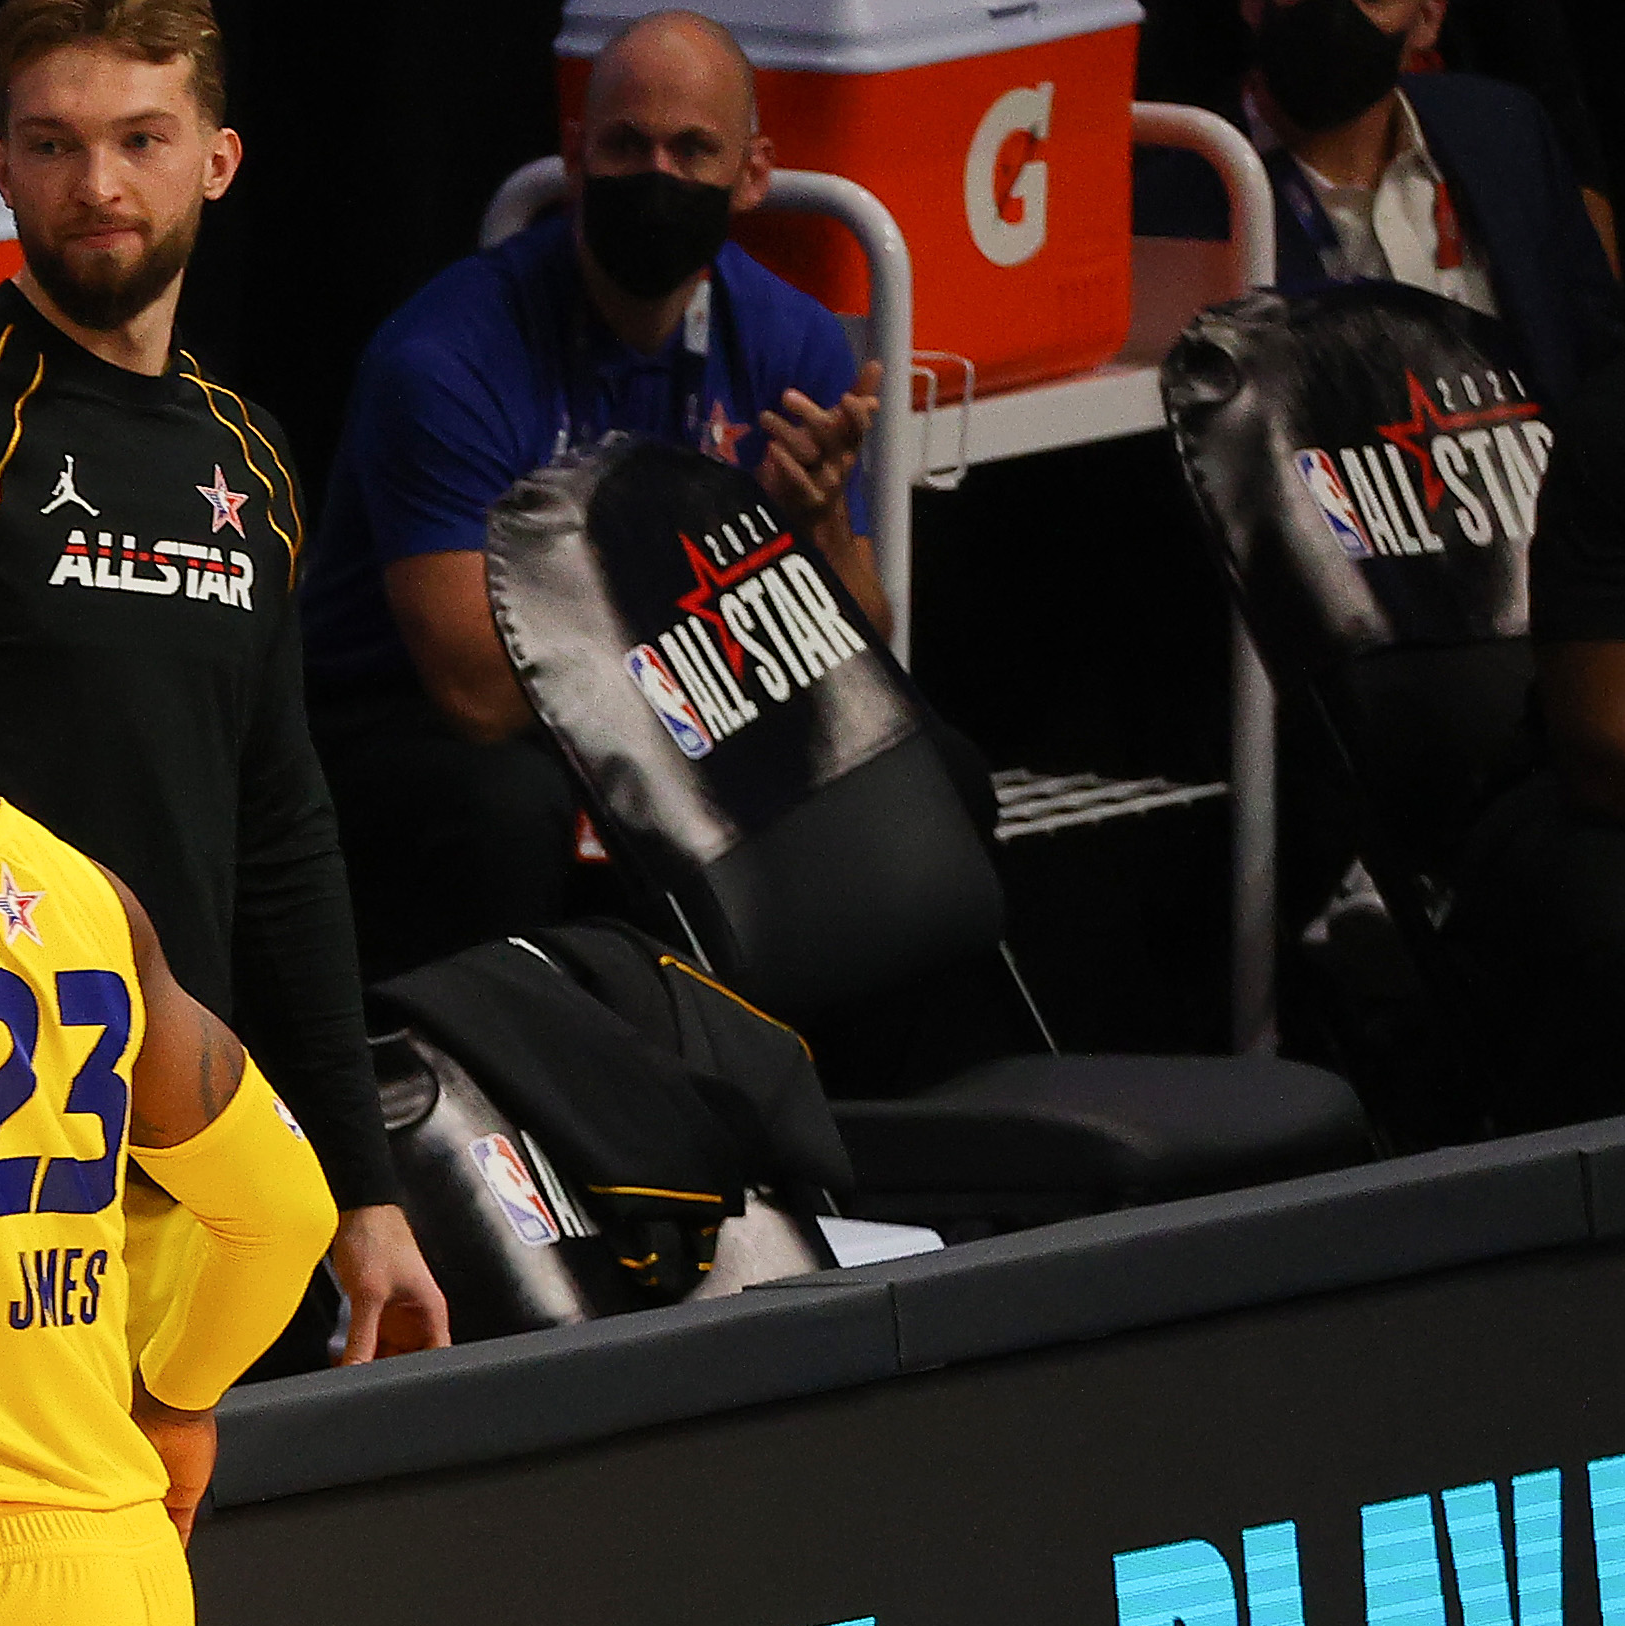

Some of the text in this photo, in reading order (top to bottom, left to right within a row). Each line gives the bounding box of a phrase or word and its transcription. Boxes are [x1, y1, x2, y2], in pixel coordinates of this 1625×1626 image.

[964, 82, 1054, 267] G
[1339, 443, 1446, 556] ALL
[659, 553, 868, 741] ALL STAR
